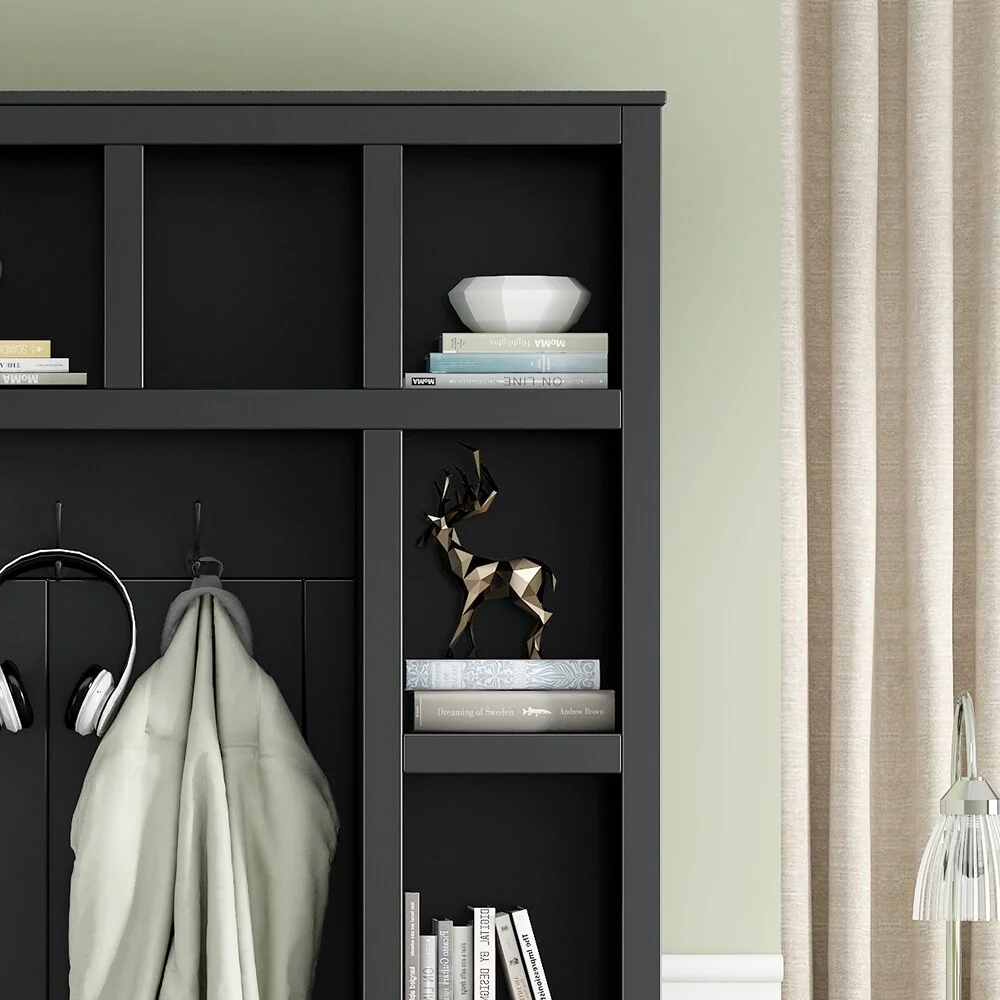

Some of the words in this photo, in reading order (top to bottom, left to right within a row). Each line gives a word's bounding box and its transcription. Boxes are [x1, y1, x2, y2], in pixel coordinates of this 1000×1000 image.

[534, 338, 566, 348] MoMA
[2, 373, 39, 384] MoMA
[503, 376, 534, 387] LINE
[542, 376, 563, 387] ON
[437, 707, 474, 719] Dreaming
[475, 706, 485, 716] of
[484, 707, 515, 717] Sweden
[559, 707, 584, 716] Andrew
[584, 707, 604, 716] Brown
